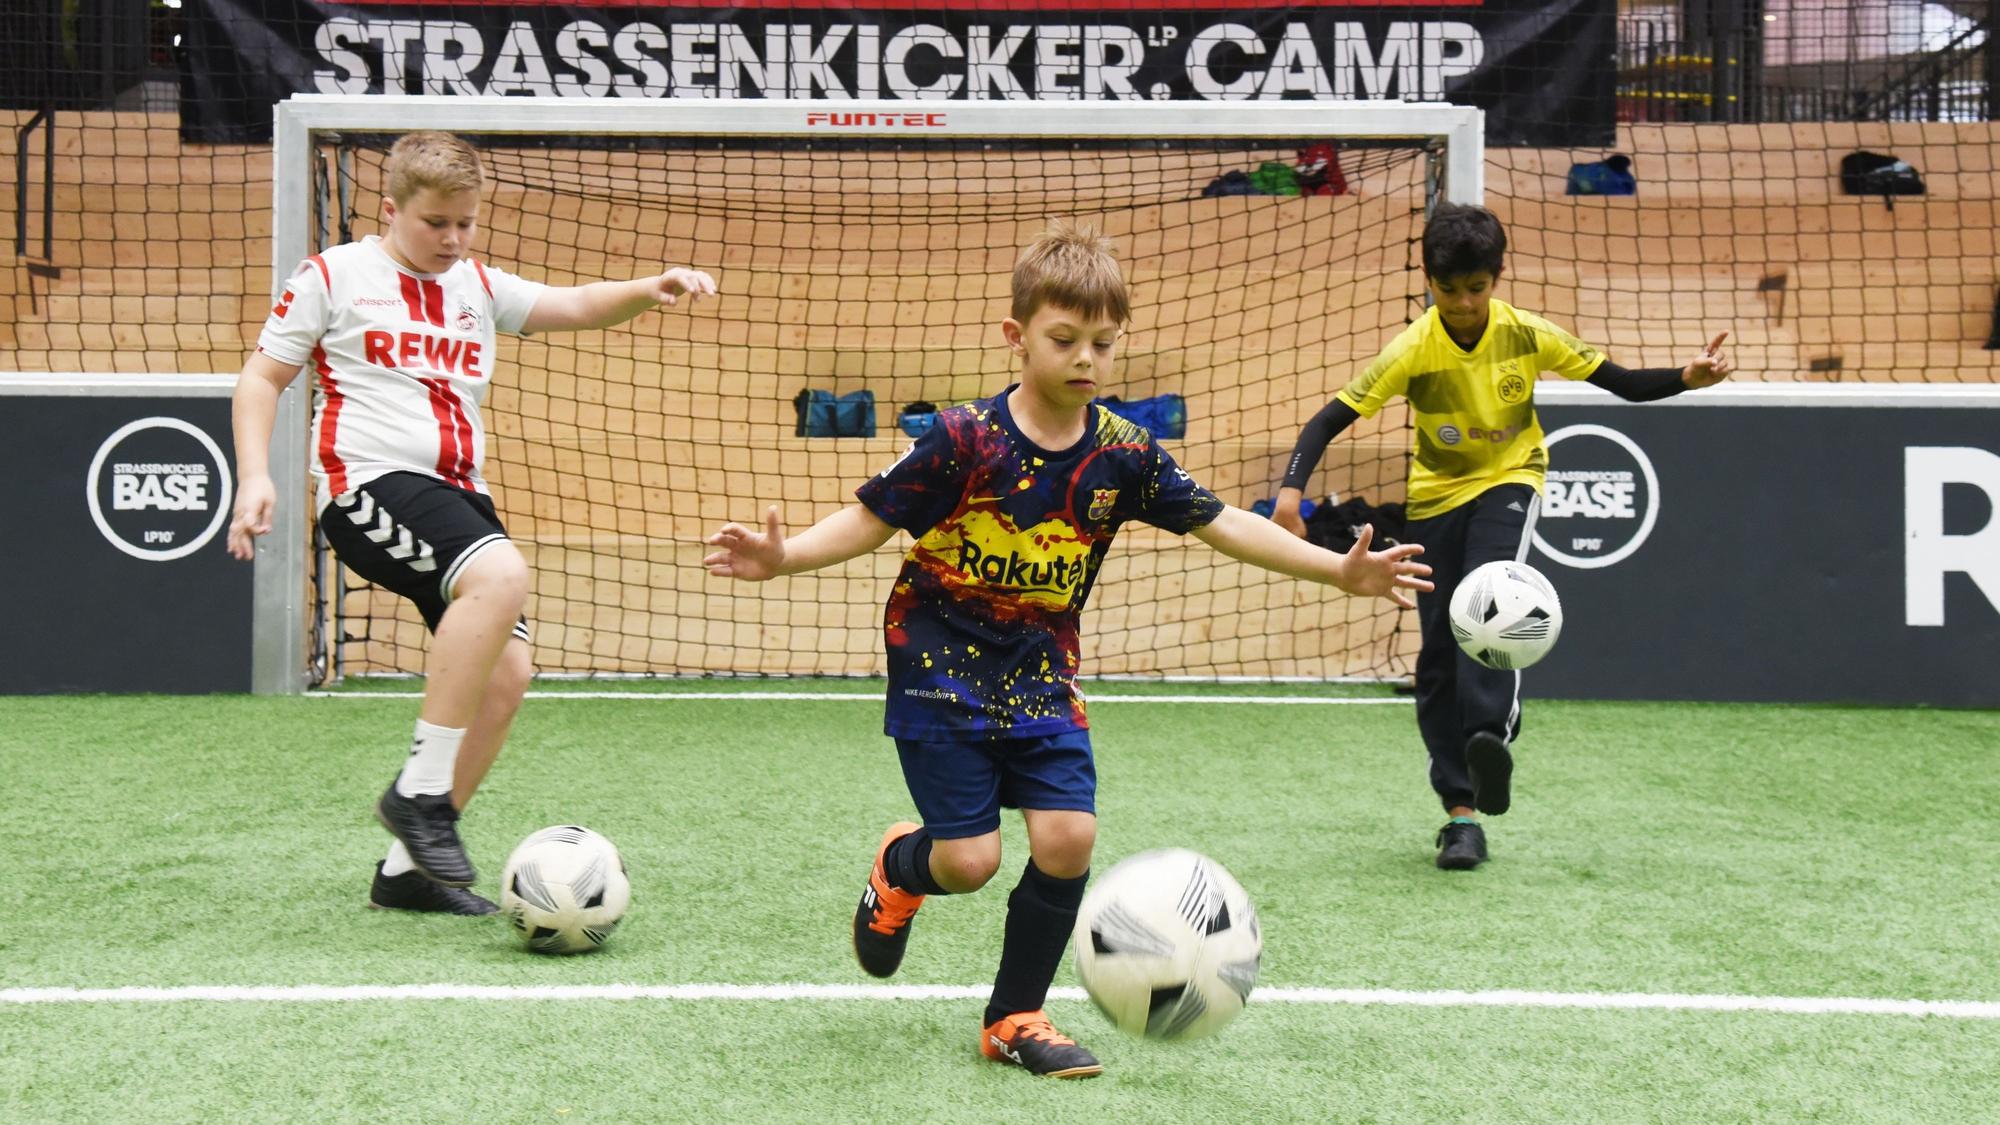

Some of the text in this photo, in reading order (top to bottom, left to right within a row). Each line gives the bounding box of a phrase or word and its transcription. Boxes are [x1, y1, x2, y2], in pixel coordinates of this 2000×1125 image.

[1148, 25, 1178, 47] LP
[1184, 21, 1485, 101] CAMP
[807, 112, 947, 126] FUNTEC
[363, 329, 483, 378] REWE
[113, 474, 209, 511] BASE
[1541, 481, 1636, 518] BASE
[904, 688, 919, 697] NIKE
